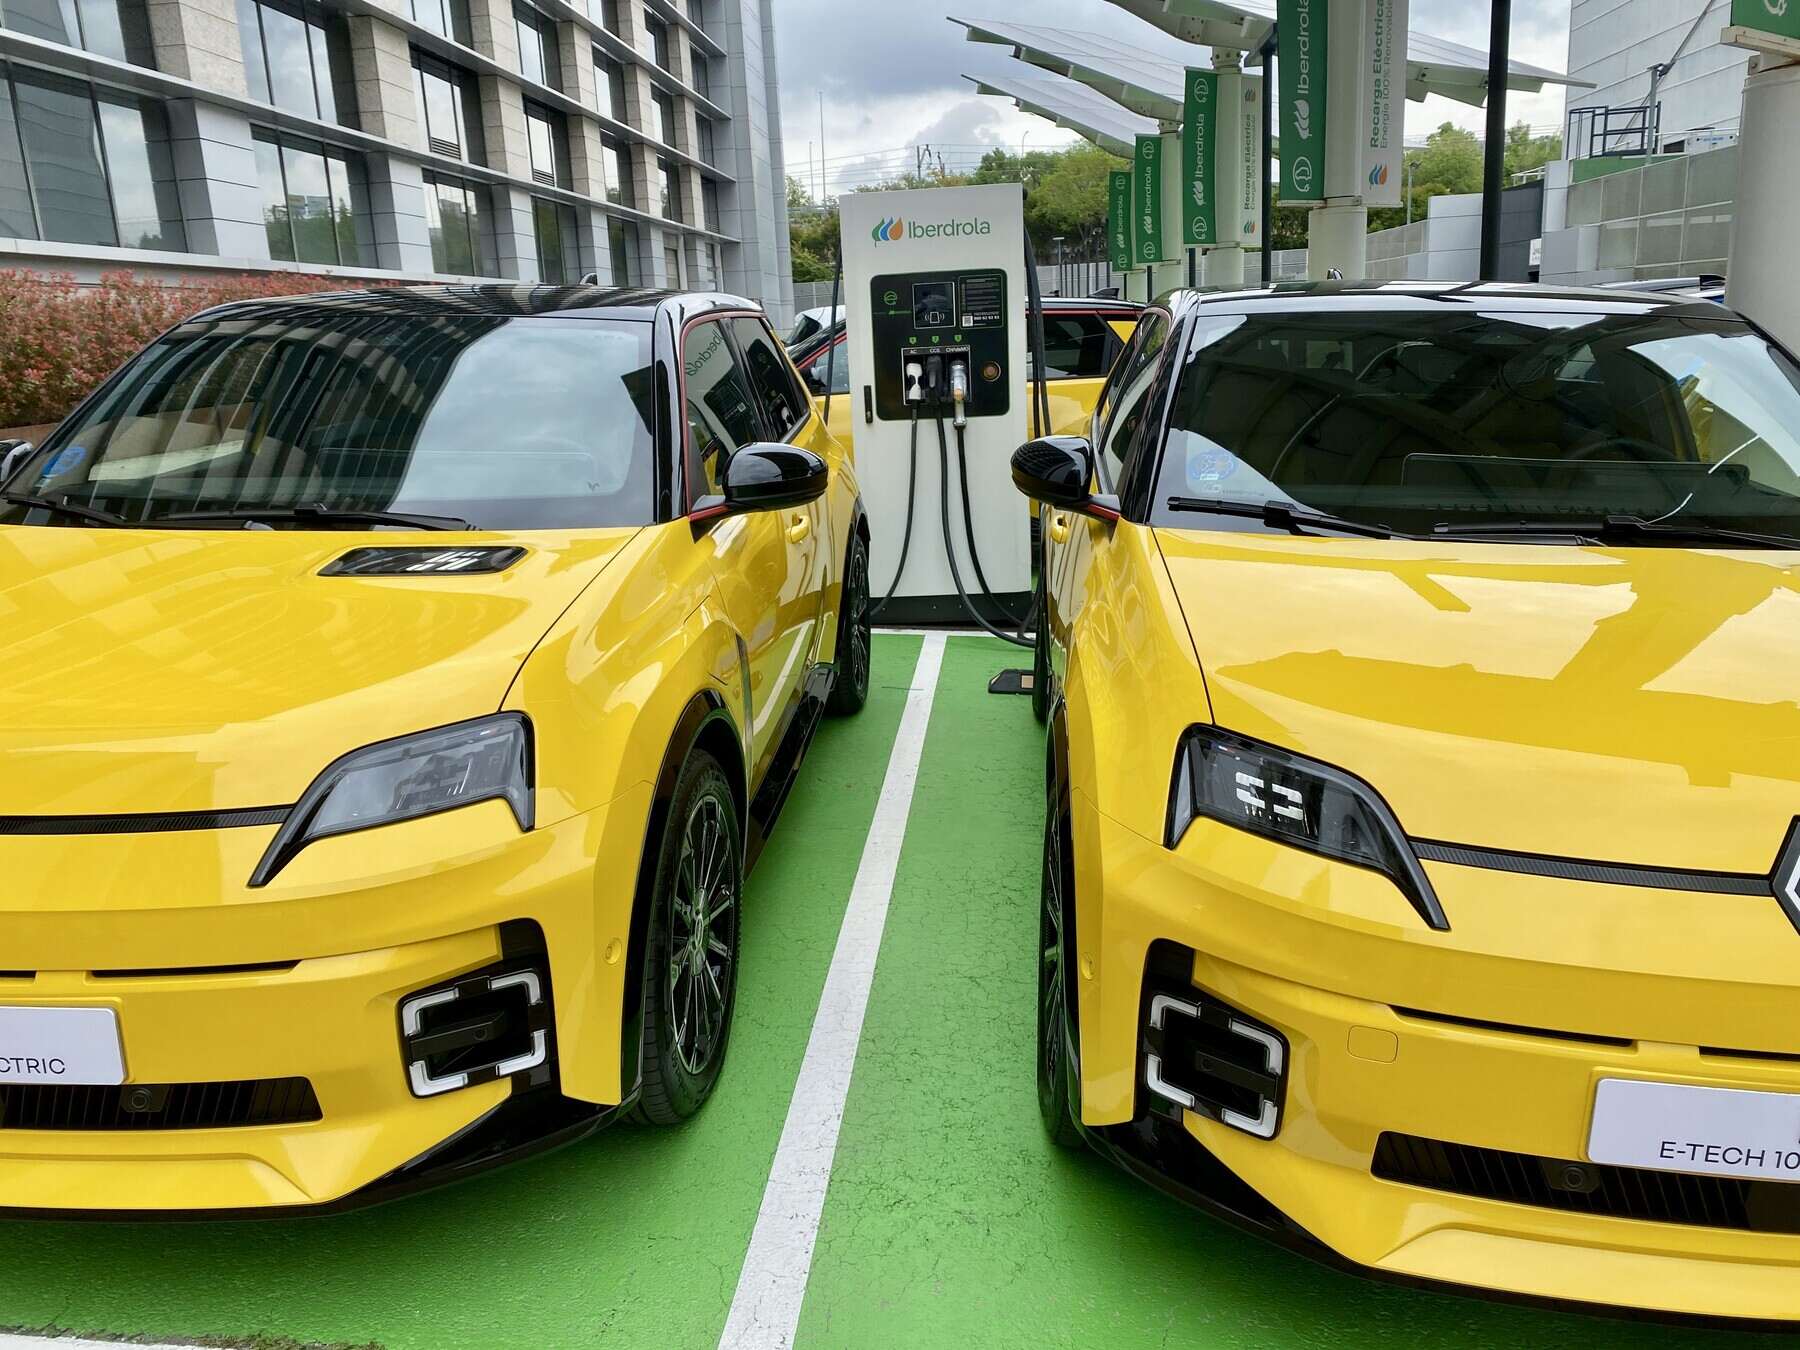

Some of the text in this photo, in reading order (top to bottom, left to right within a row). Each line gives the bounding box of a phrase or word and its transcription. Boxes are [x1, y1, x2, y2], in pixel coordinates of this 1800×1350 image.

[1370, 78, 1383, 148] Recarga
[1195, 113, 1204, 178] Iberdrola
[1144, 166, 1152, 214] Iberdrola
[908, 217, 991, 239] Iberdrola
[1659, 1140, 1766, 1168] E-TECH
